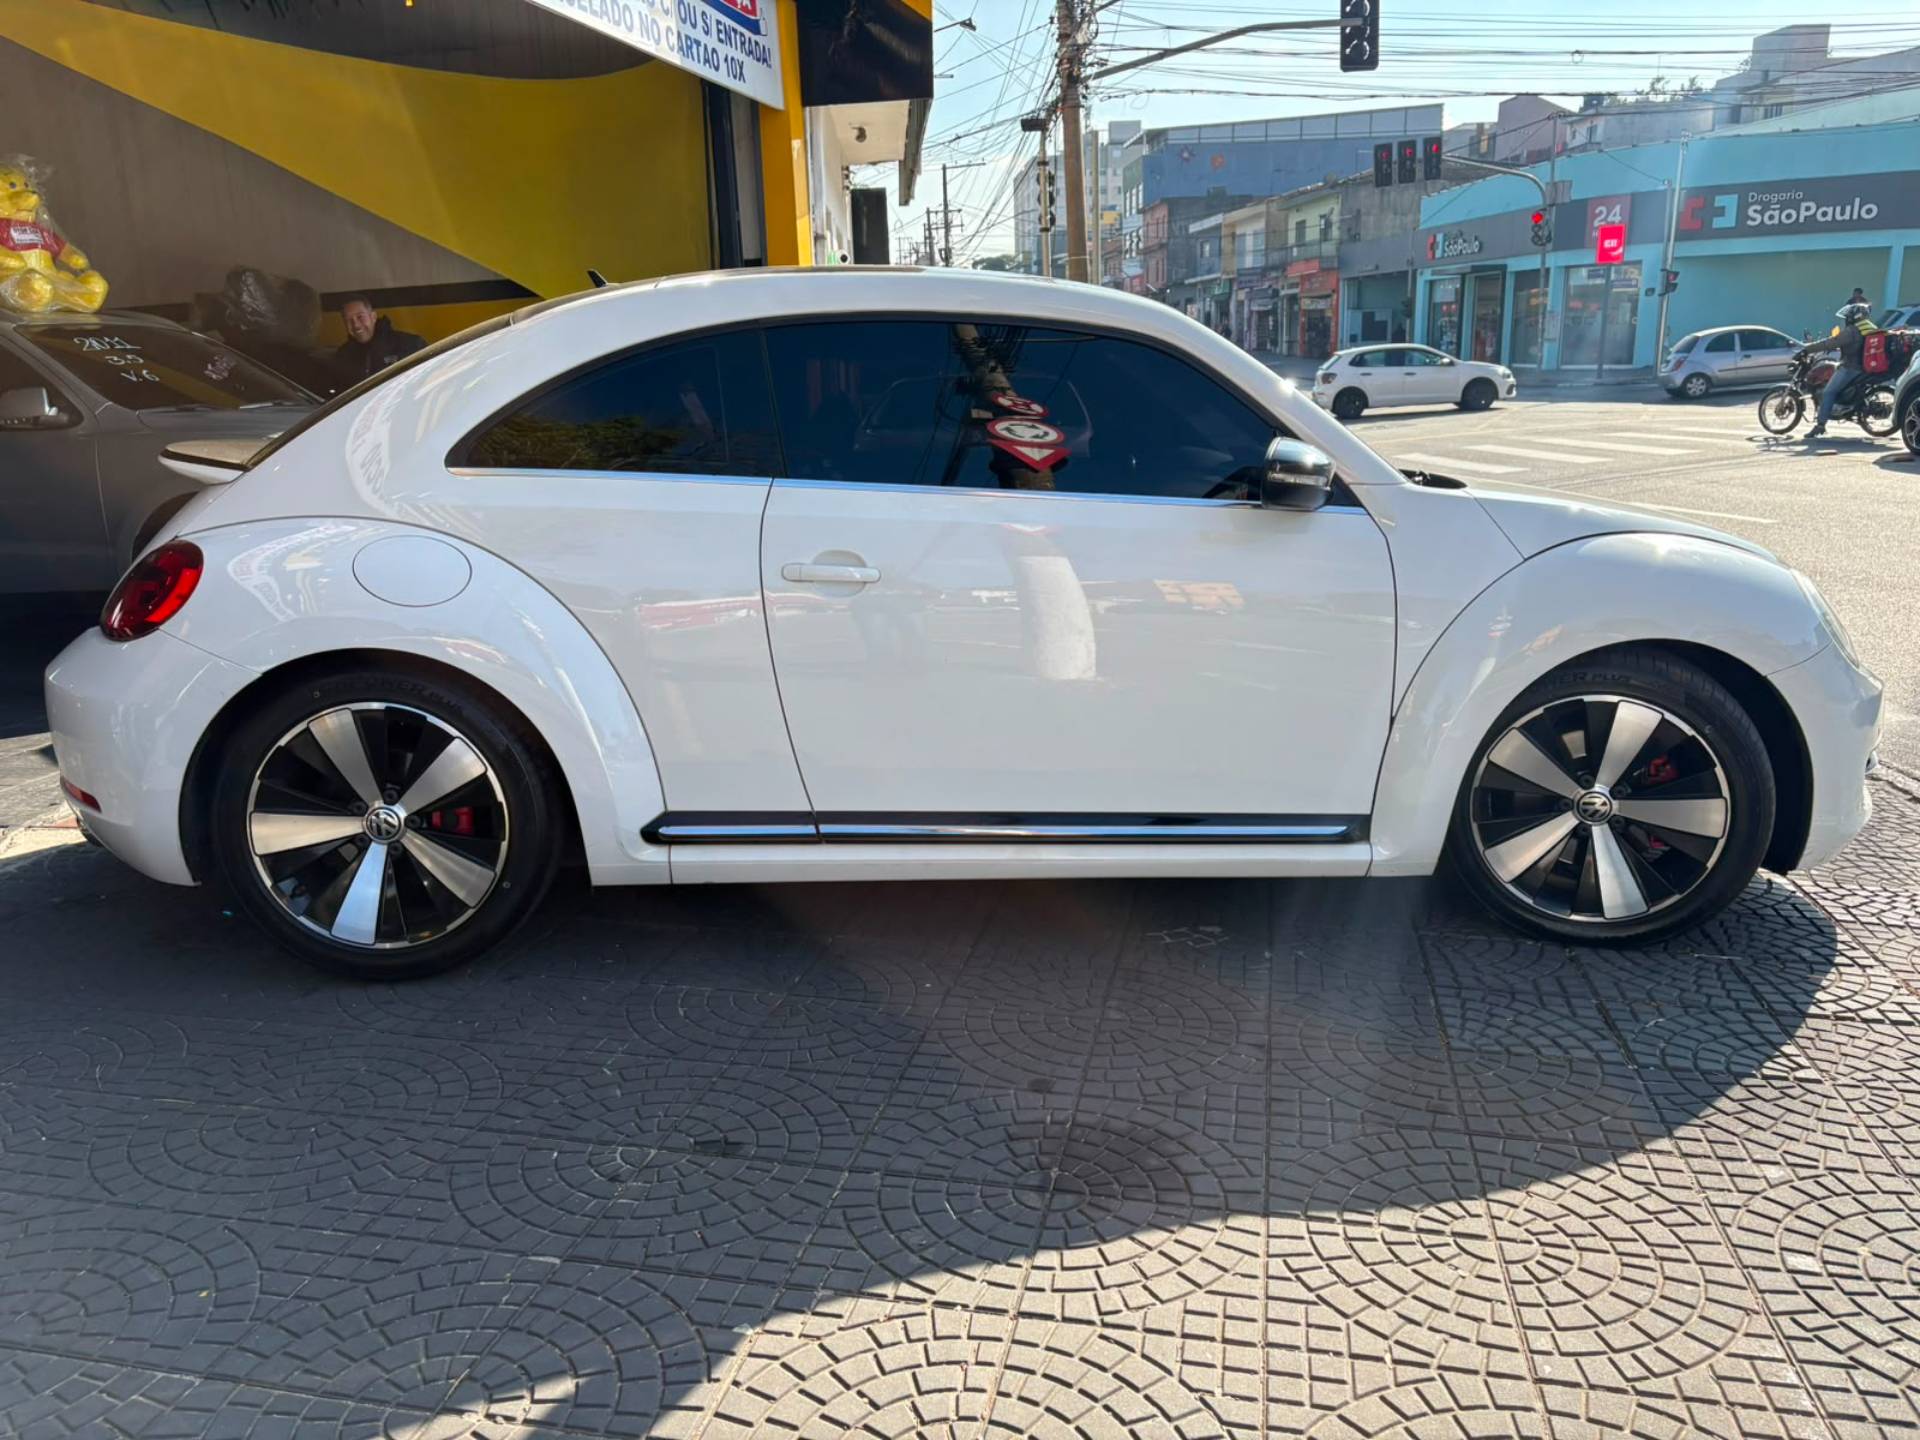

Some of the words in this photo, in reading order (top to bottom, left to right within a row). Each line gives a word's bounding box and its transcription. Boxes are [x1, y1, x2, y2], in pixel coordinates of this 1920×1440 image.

[639, 10, 661, 46] NO
[666, 24, 720, 72] CARTAO
[724, 53, 746, 83] 10X
[678, 0, 698, 30] OU
[701, 10, 713, 39] S/
[715, 18, 772, 69] ENTRADA!
[1748, 189, 1804, 204] Drogaria
[1593, 203, 1622, 228] 24
[1746, 197, 1879, 227] SãoPaulo
